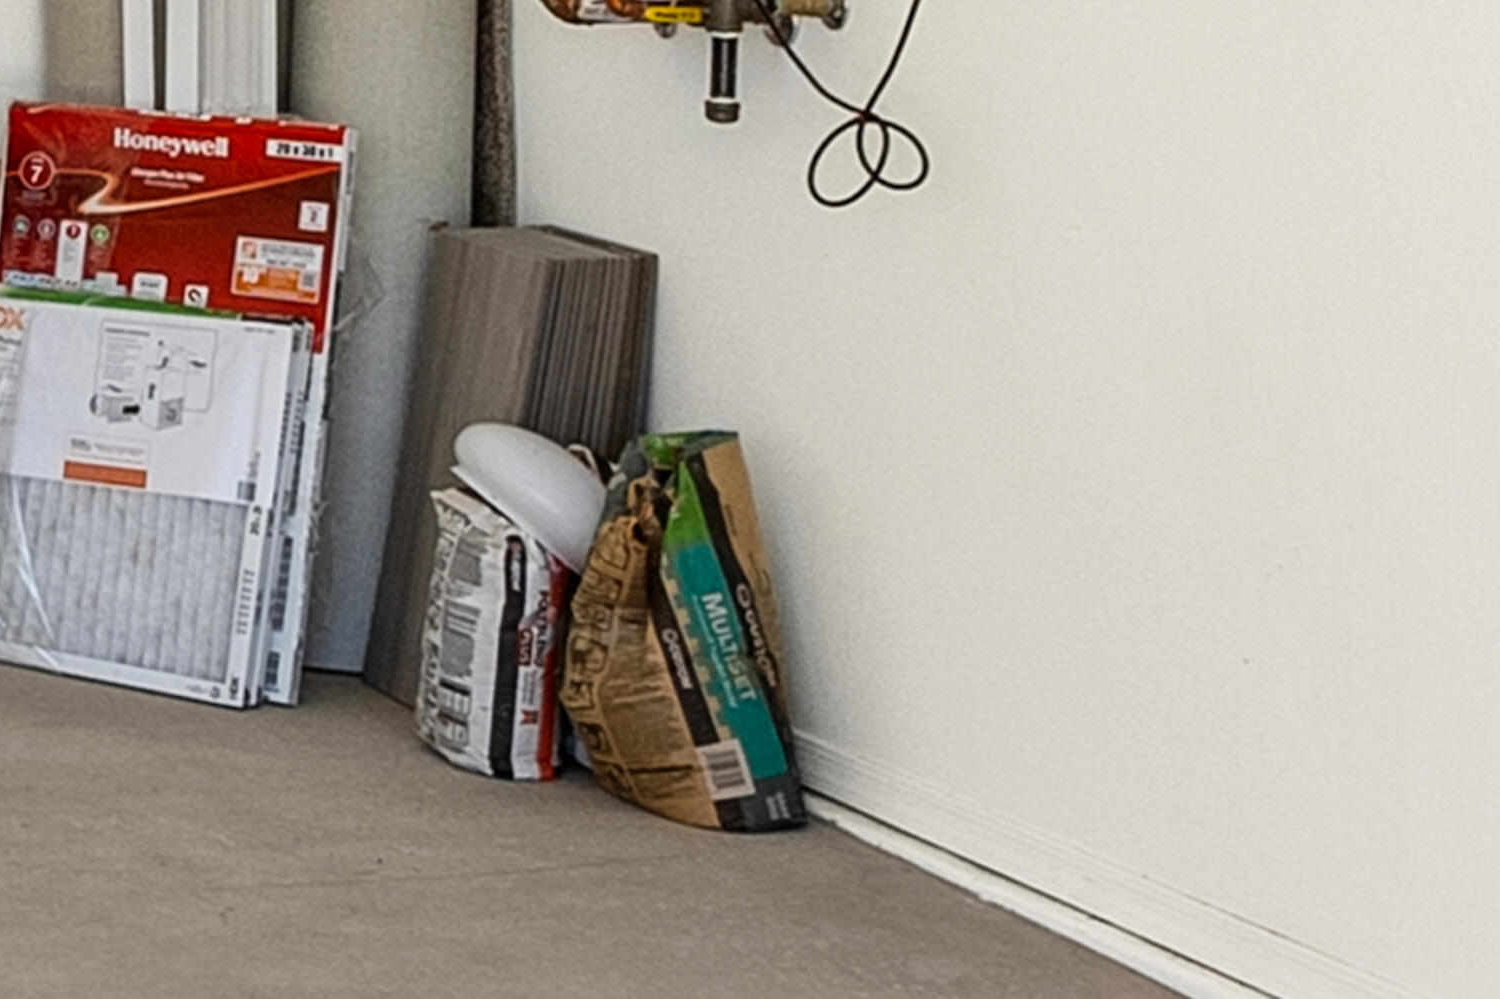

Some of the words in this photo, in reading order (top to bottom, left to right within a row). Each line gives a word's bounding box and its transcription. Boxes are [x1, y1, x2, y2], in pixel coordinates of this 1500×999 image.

[114, 127, 229, 158] Honeywell
[31, 165, 43, 183] 7
[702, 592, 757, 700] MULTISET
